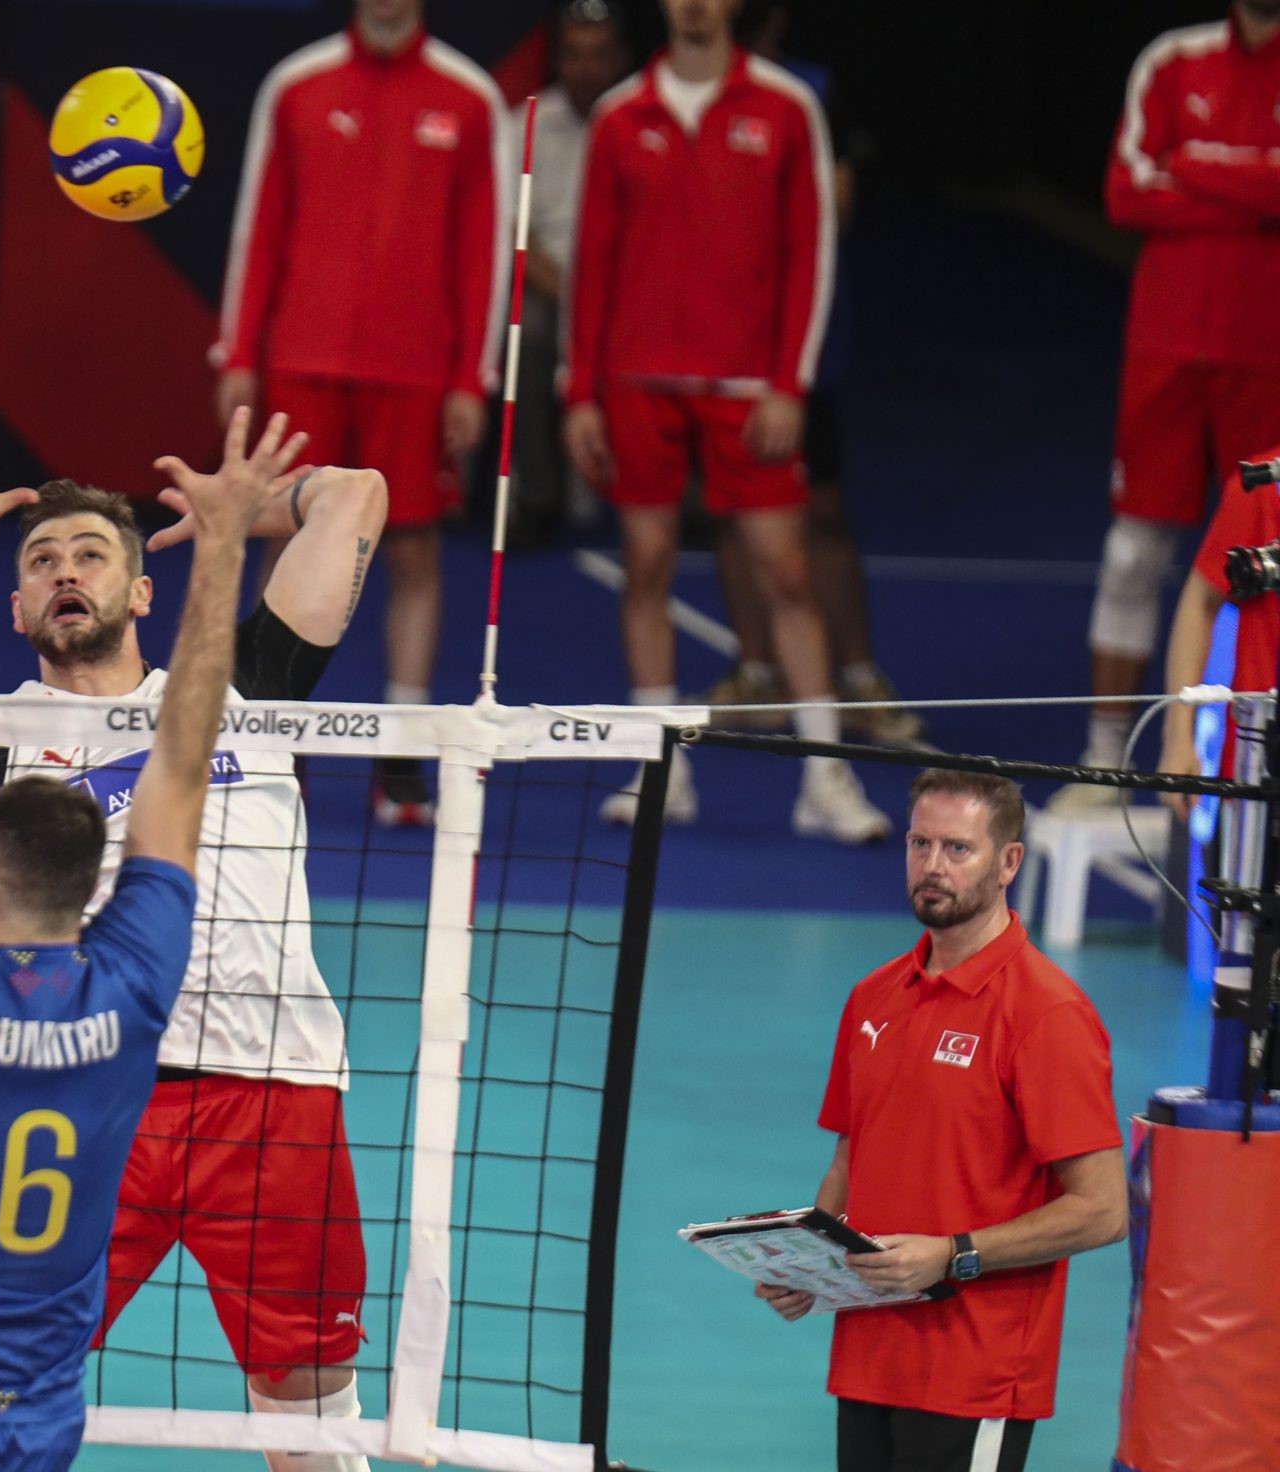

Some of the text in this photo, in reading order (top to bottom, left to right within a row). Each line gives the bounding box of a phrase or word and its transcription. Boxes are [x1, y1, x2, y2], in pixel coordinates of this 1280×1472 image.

[107, 707, 380, 741] CEV oVolley 2023
[549, 720, 611, 741] CEV
[108, 787, 137, 812] AX
[943, 1052, 963, 1062] TUR
